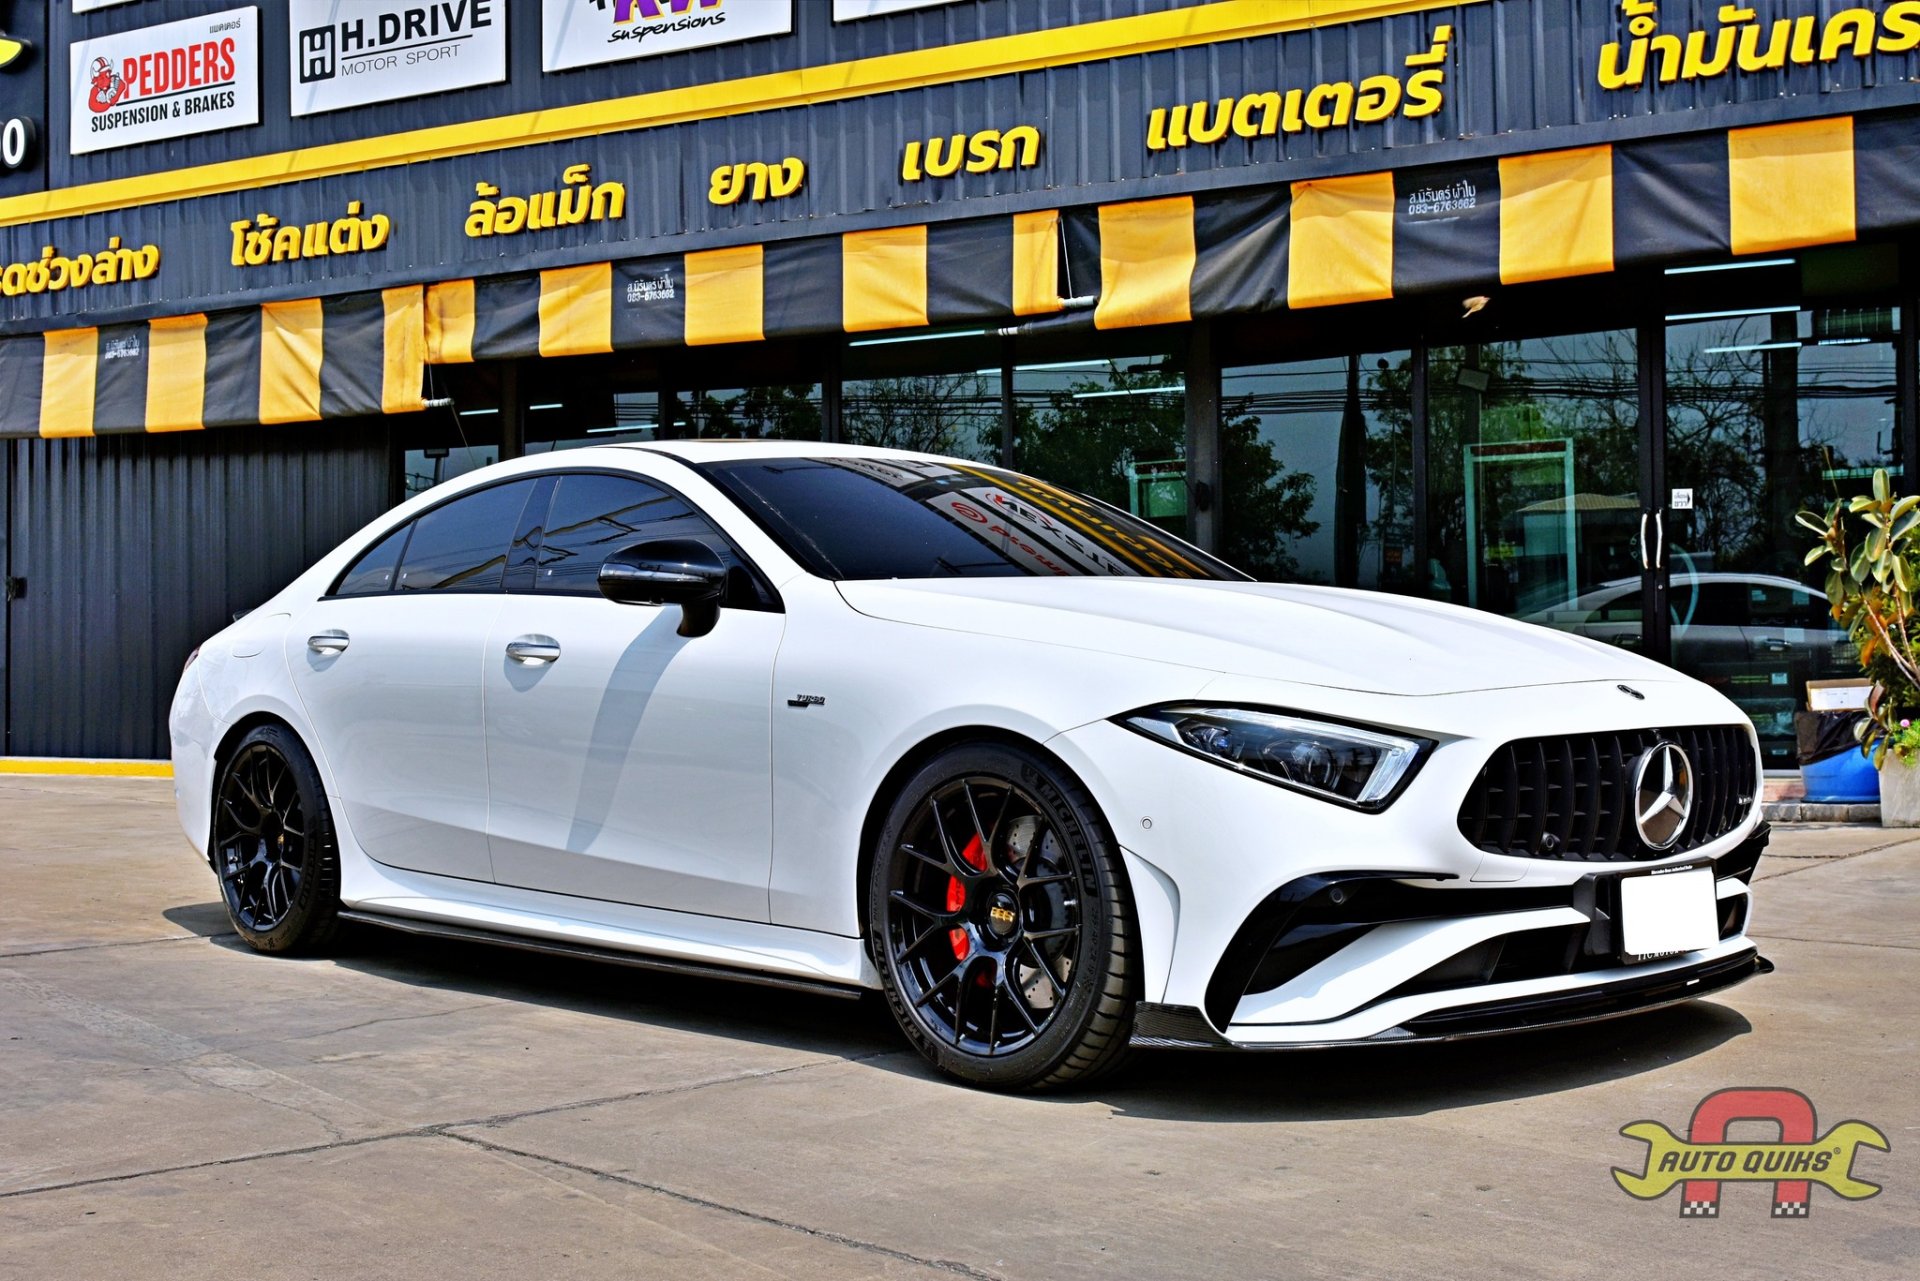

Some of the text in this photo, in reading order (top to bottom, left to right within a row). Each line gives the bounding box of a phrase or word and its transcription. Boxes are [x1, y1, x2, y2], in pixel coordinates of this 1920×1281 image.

[341, 0, 492, 52] H.DRIVE
[607, 12, 726, 43] suspensions
[123, 37, 235, 99] PEDDERS
[341, 44, 461, 77] MOTOR SPORT
[1147, 25, 1453, 151] แบตเตอรี่
[91, 91, 235, 133] SUSPENSION & BRAKES
[903, 125, 1041, 181] เบรก
[464, 163, 625, 239] ล้อแม็ก
[708, 157, 806, 206] ยาง
[230, 201, 389, 267] โช้คแต่ง
[0, 236, 160, 297] ดช่วงล่าง
[1038, 782, 1097, 890] MICHELIN
[990, 906, 1016, 922] BBS
